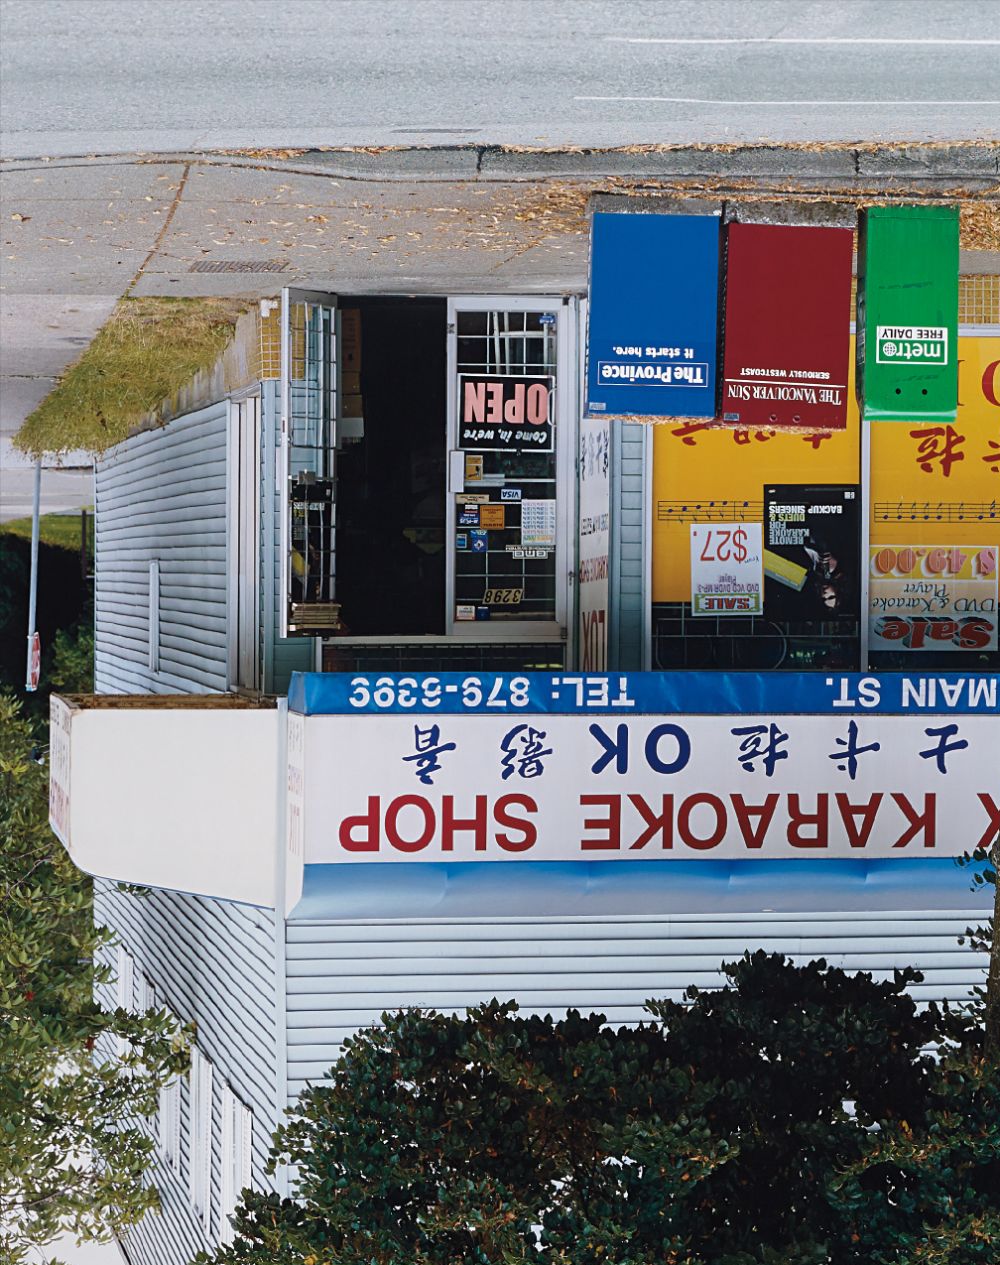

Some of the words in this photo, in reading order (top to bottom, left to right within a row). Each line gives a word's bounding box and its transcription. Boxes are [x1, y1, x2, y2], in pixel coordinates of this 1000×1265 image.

[881, 328, 914, 339] DAILY
[916, 328, 944, 340] FREE
[612, 346, 643, 358] here.
[645, 346, 681, 359] starts
[683, 348, 694, 359] It
[882, 341, 942, 360] metro
[601, 364, 672, 383] Province
[674, 366, 703, 384] The
[740, 367, 787, 378] WESTCOAST
[788, 369, 830, 380] SERIOUSLY
[727, 384, 751, 401] SUN
[752, 385, 818, 404] VANCOUVER
[818, 388, 842, 406] THE
[464, 382, 548, 425] OPEN
[463, 429, 495, 441] we're
[497, 429, 513, 443] in,
[515, 430, 547, 444] Come
[502, 490, 519, 499] VISA
[768, 505, 806, 514] SINGERS
[807, 505, 843, 514] BACKUP
[778, 513, 805, 522] DUETS
[769, 521, 786, 529] FOR
[769, 528, 810, 536] KARAOKE
[769, 536, 804, 545] REMOTE
[483, 589, 521, 604] 3298
[903, 582, 950, 598] Player
[704, 597, 750, 610] SALE
[871, 597, 937, 612] Karaoke
[954, 597, 996, 613] DVD
[872, 615, 994, 649] Sale
[551, 677, 635, 707] TEL:
[825, 677, 881, 707] ST.
[901, 677, 998, 708] MAIN
[338, 793, 539, 853] SHOP
[578, 792, 937, 851] KARAOKE
